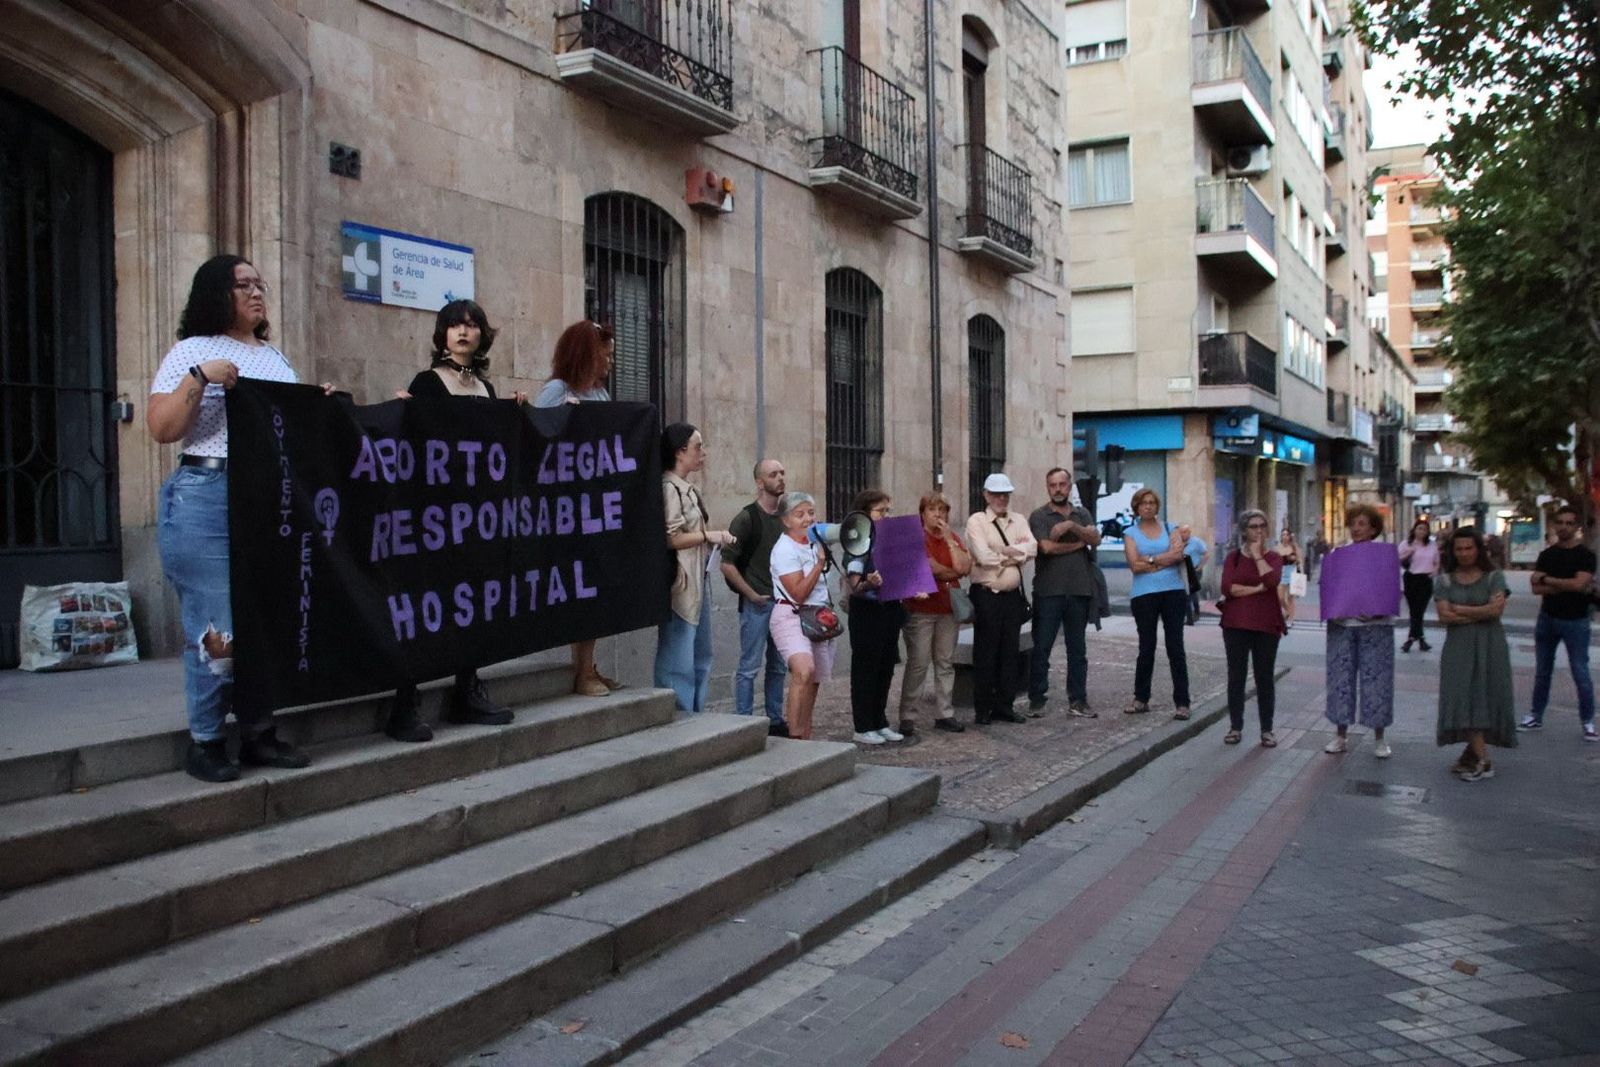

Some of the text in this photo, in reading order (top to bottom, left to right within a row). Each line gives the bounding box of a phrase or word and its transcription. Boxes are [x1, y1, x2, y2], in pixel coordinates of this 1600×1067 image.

[392, 248, 464, 272] Gerencia de Salud
[392, 264, 404, 276] de
[350, 434, 637, 486] ABORTO LEGAL
[371, 491, 622, 562] RESPONSABLE
[299, 531, 314, 672] FEMINISTA
[388, 561, 597, 640] HOSPITAL
